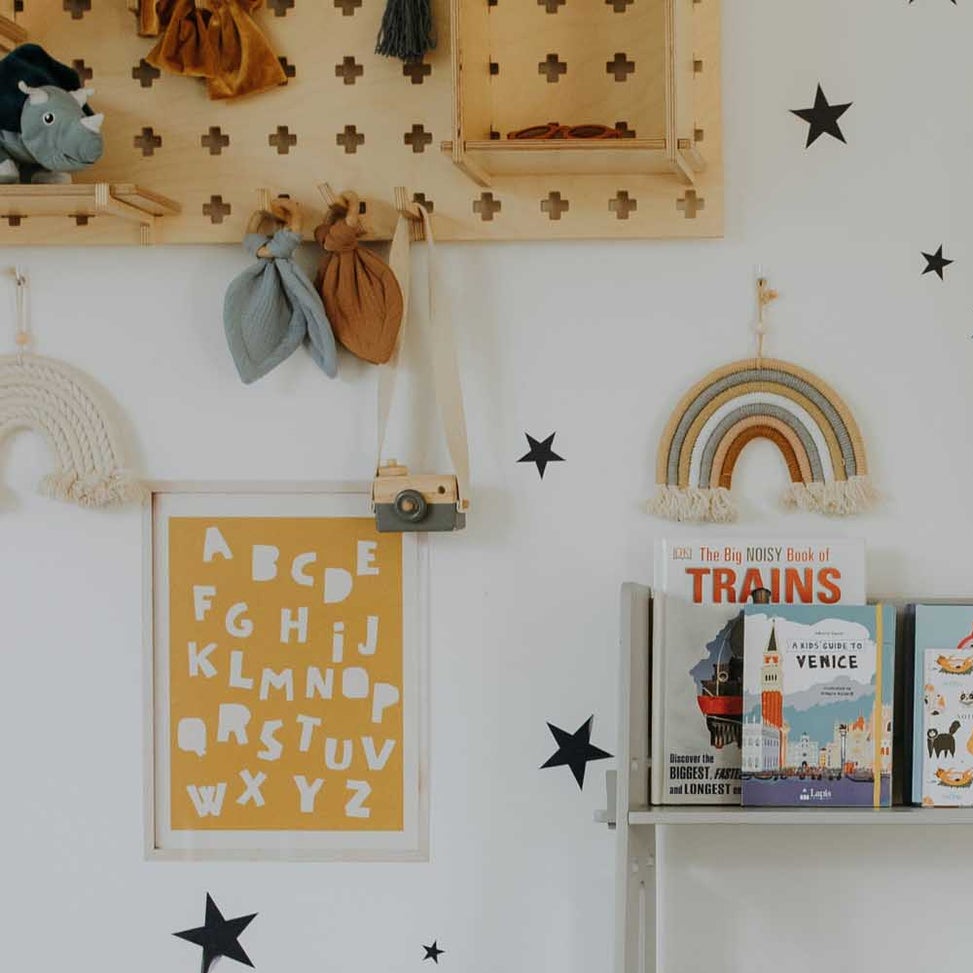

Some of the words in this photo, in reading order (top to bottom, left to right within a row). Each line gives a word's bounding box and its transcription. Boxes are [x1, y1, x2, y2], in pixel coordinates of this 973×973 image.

[203, 526, 233, 563] A
[252, 544, 280, 582] B
[291, 551, 317, 587] C
[323, 567, 353, 604] D
[357, 540, 380, 576] E
[700, 547, 719, 562] The
[725, 547, 742, 565] Big
[746, 547, 782, 562] NOISY
[787, 547, 814, 562] Book
[819, 546, 830, 562] of
[685, 567, 842, 604] TRAINS
[192, 584, 217, 622] F
[225, 602, 254, 638] G
[280, 606, 309, 644] H
[357, 615, 379, 656] J
[822, 642, 847, 650] GUIDE
[851, 642, 863, 650] TO
[796, 654, 858, 669] VENICE
[187, 641, 218, 678] K
[228, 650, 254, 690] L
[259, 667, 294, 702] M
[305, 666, 334, 700] N
[341, 666, 370, 699] O
[371, 682, 400, 724] P
[177, 717, 207, 757] Q
[216, 703, 252, 745] R
[257, 719, 284, 762] S
[296, 714, 322, 752] T
[324, 737, 353, 771] U
[361, 735, 396, 771] V
[669, 753, 701, 764] Discover
[702, 753, 714, 764] the
[714, 768, 742, 780] FASTE
[186, 782, 227, 818] W
[236, 769, 267, 807] X
[293, 775, 325, 813] Y
[344, 779, 372, 819] Z
[669, 785, 683, 795] and
[684, 783, 731, 795] LONGEST
